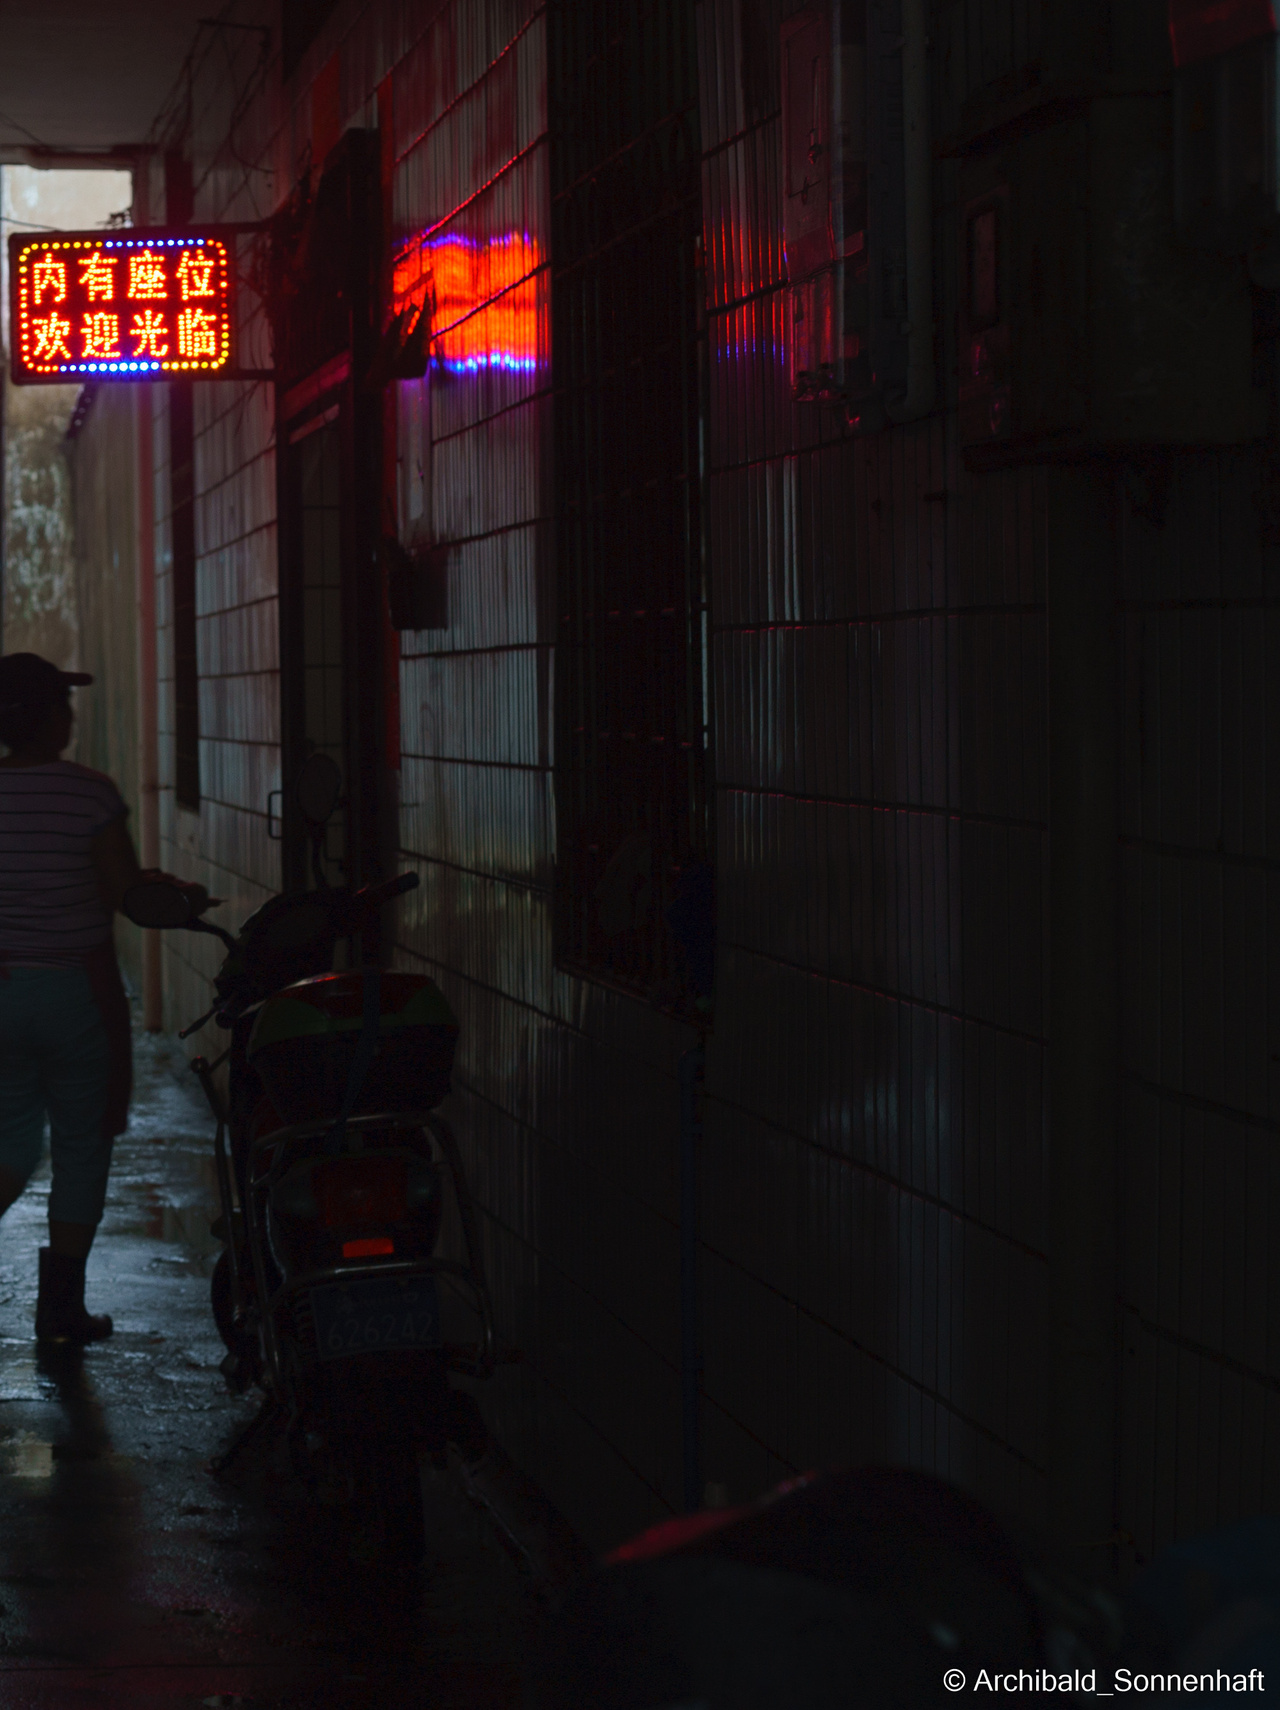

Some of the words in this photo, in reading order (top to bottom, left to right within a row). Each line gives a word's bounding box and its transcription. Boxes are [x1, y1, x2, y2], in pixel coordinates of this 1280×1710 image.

[32, 250, 215, 304] 内有座位
[32, 308, 217, 360] 欢迎光临
[329, 1310, 433, 1350] 626242
